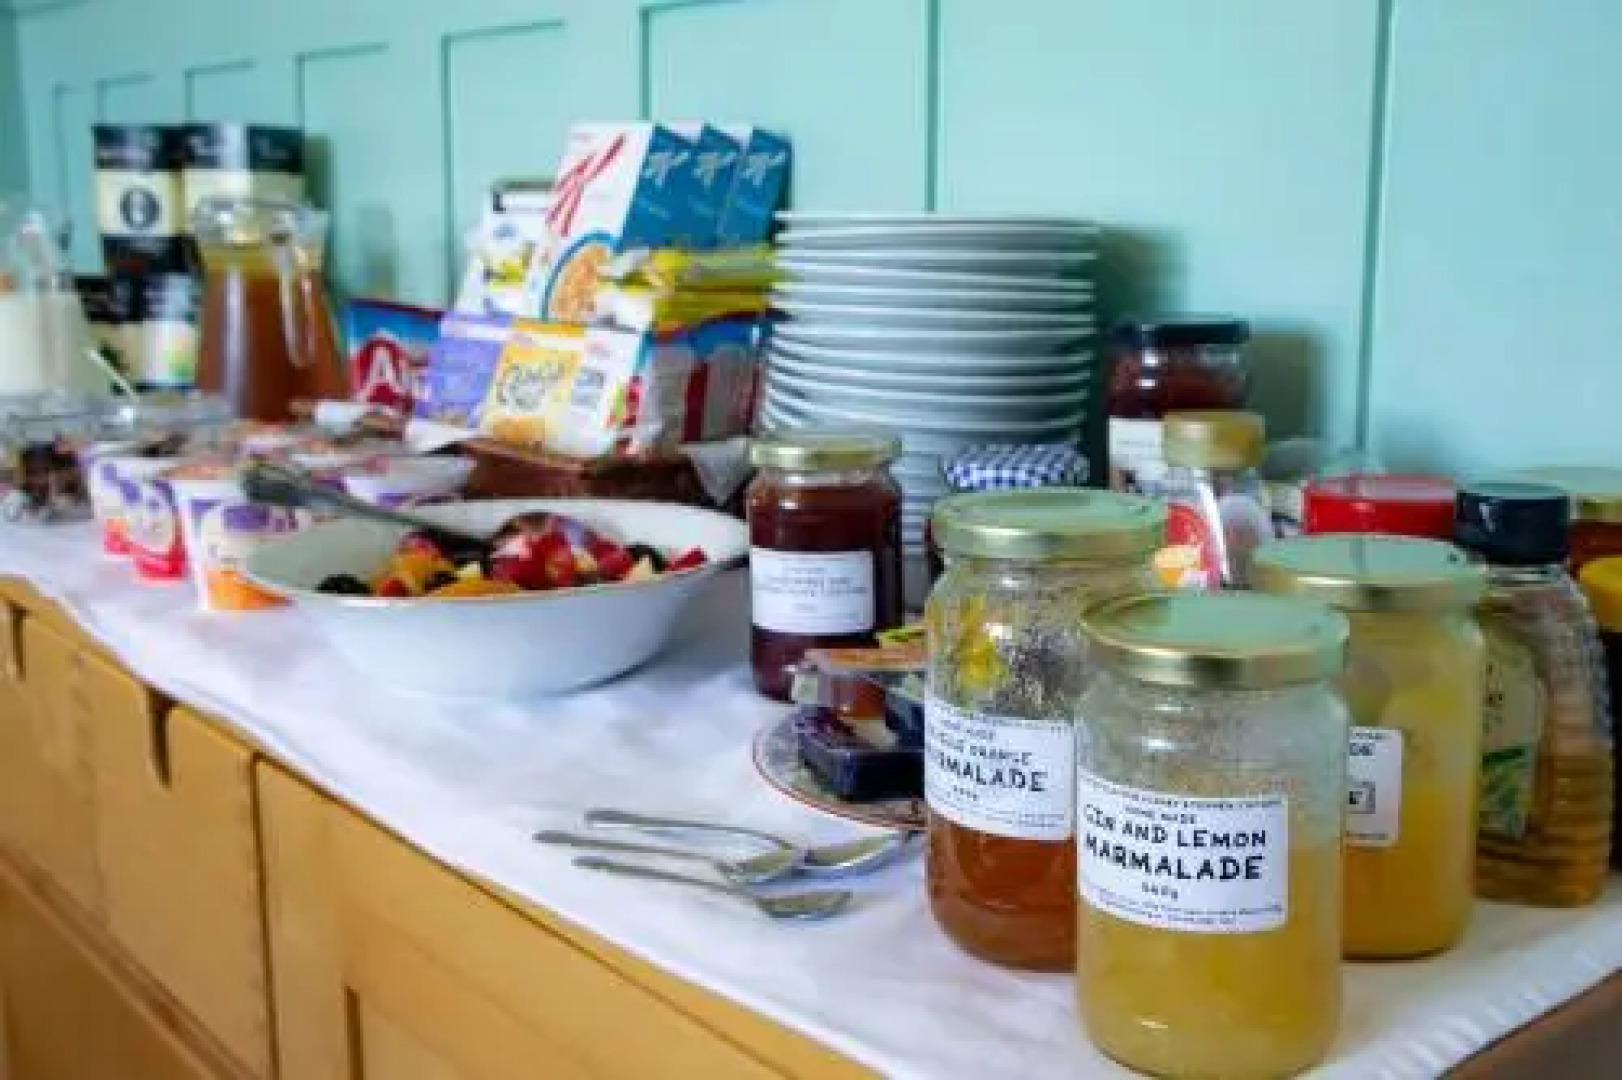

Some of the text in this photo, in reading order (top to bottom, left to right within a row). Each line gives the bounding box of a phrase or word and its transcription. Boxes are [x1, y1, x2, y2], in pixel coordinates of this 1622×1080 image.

[1083, 803, 1117, 832] GIN
[1122, 819, 1169, 845] AND
[1176, 828, 1267, 850] LEMON
[1085, 831, 1266, 882] MARMALADE
